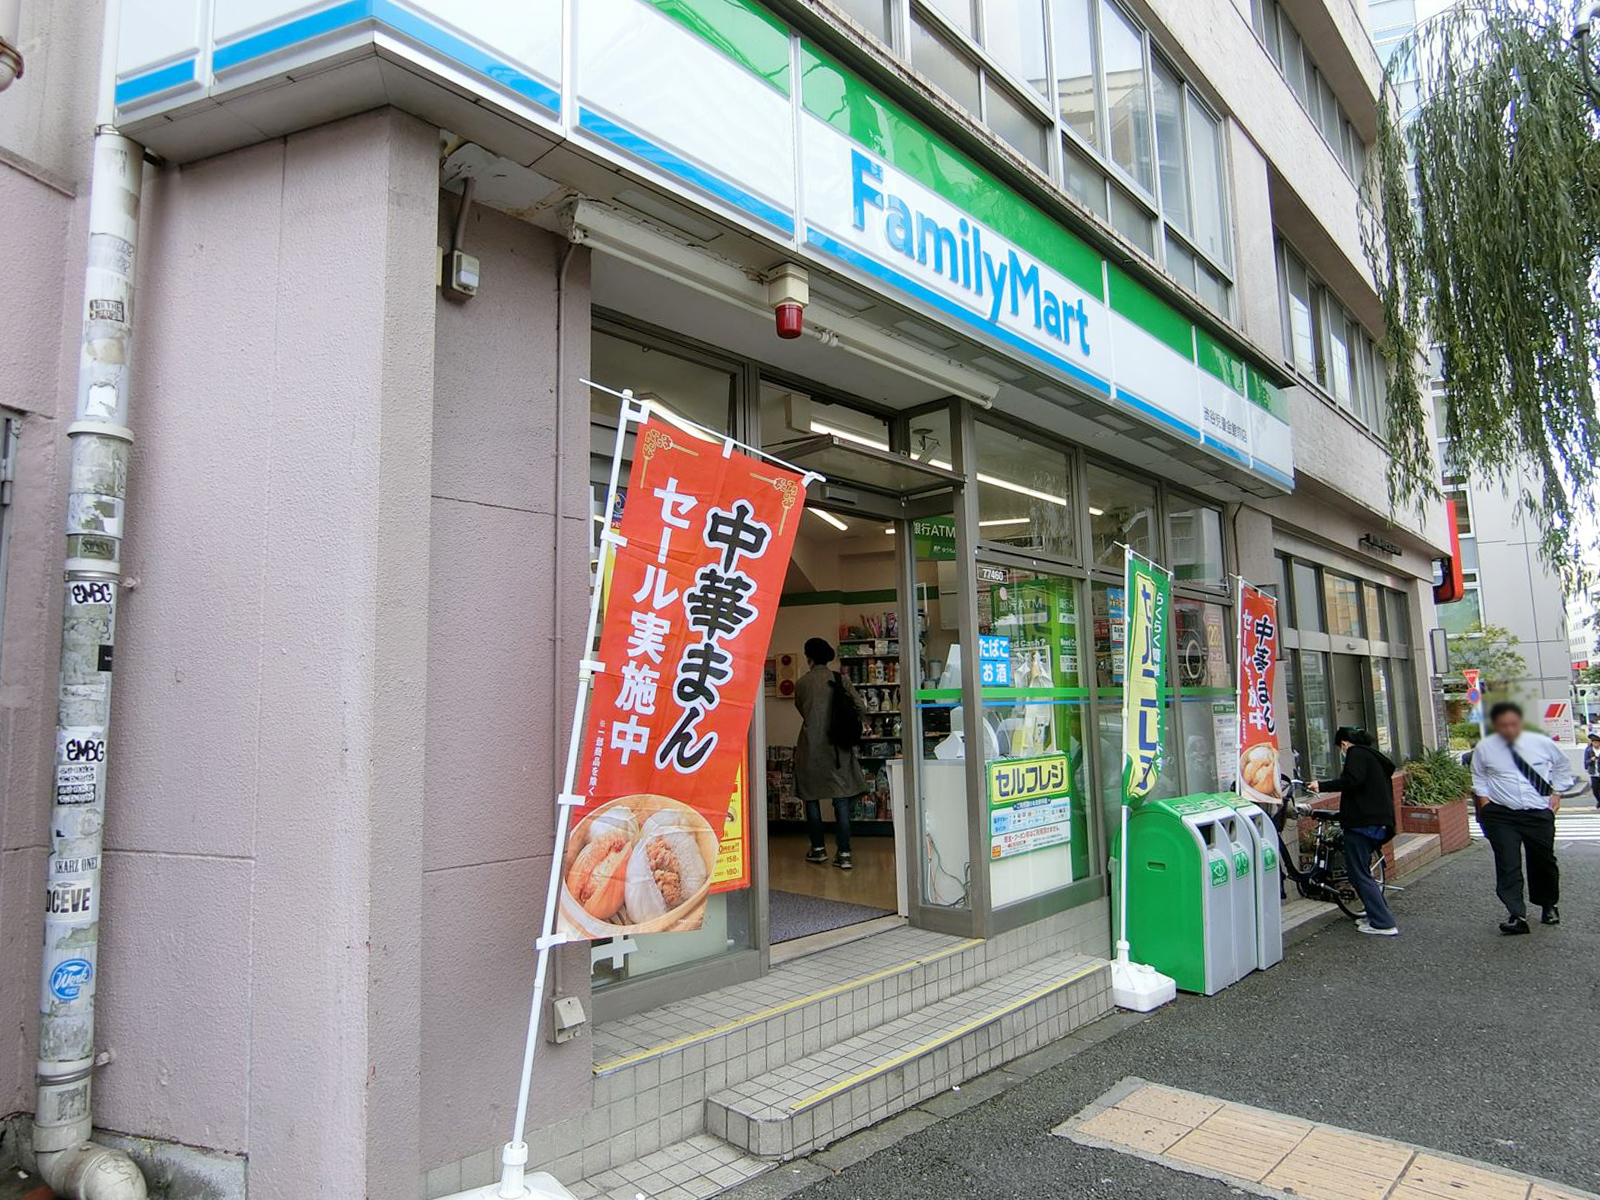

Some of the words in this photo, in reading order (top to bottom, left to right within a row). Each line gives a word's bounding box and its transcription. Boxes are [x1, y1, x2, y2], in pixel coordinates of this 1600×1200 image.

[851, 148, 1090, 356] FamilyMart
[983, 568, 1004, 581] 77460
[609, 477, 699, 766] セール実施中
[655, 499, 772, 774] 中華まん
[979, 637, 1009, 659] たばこ
[983, 662, 1007, 683] お酒
[1243, 609, 1266, 730] セール施中
[995, 763, 1064, 797] セルフレジ
